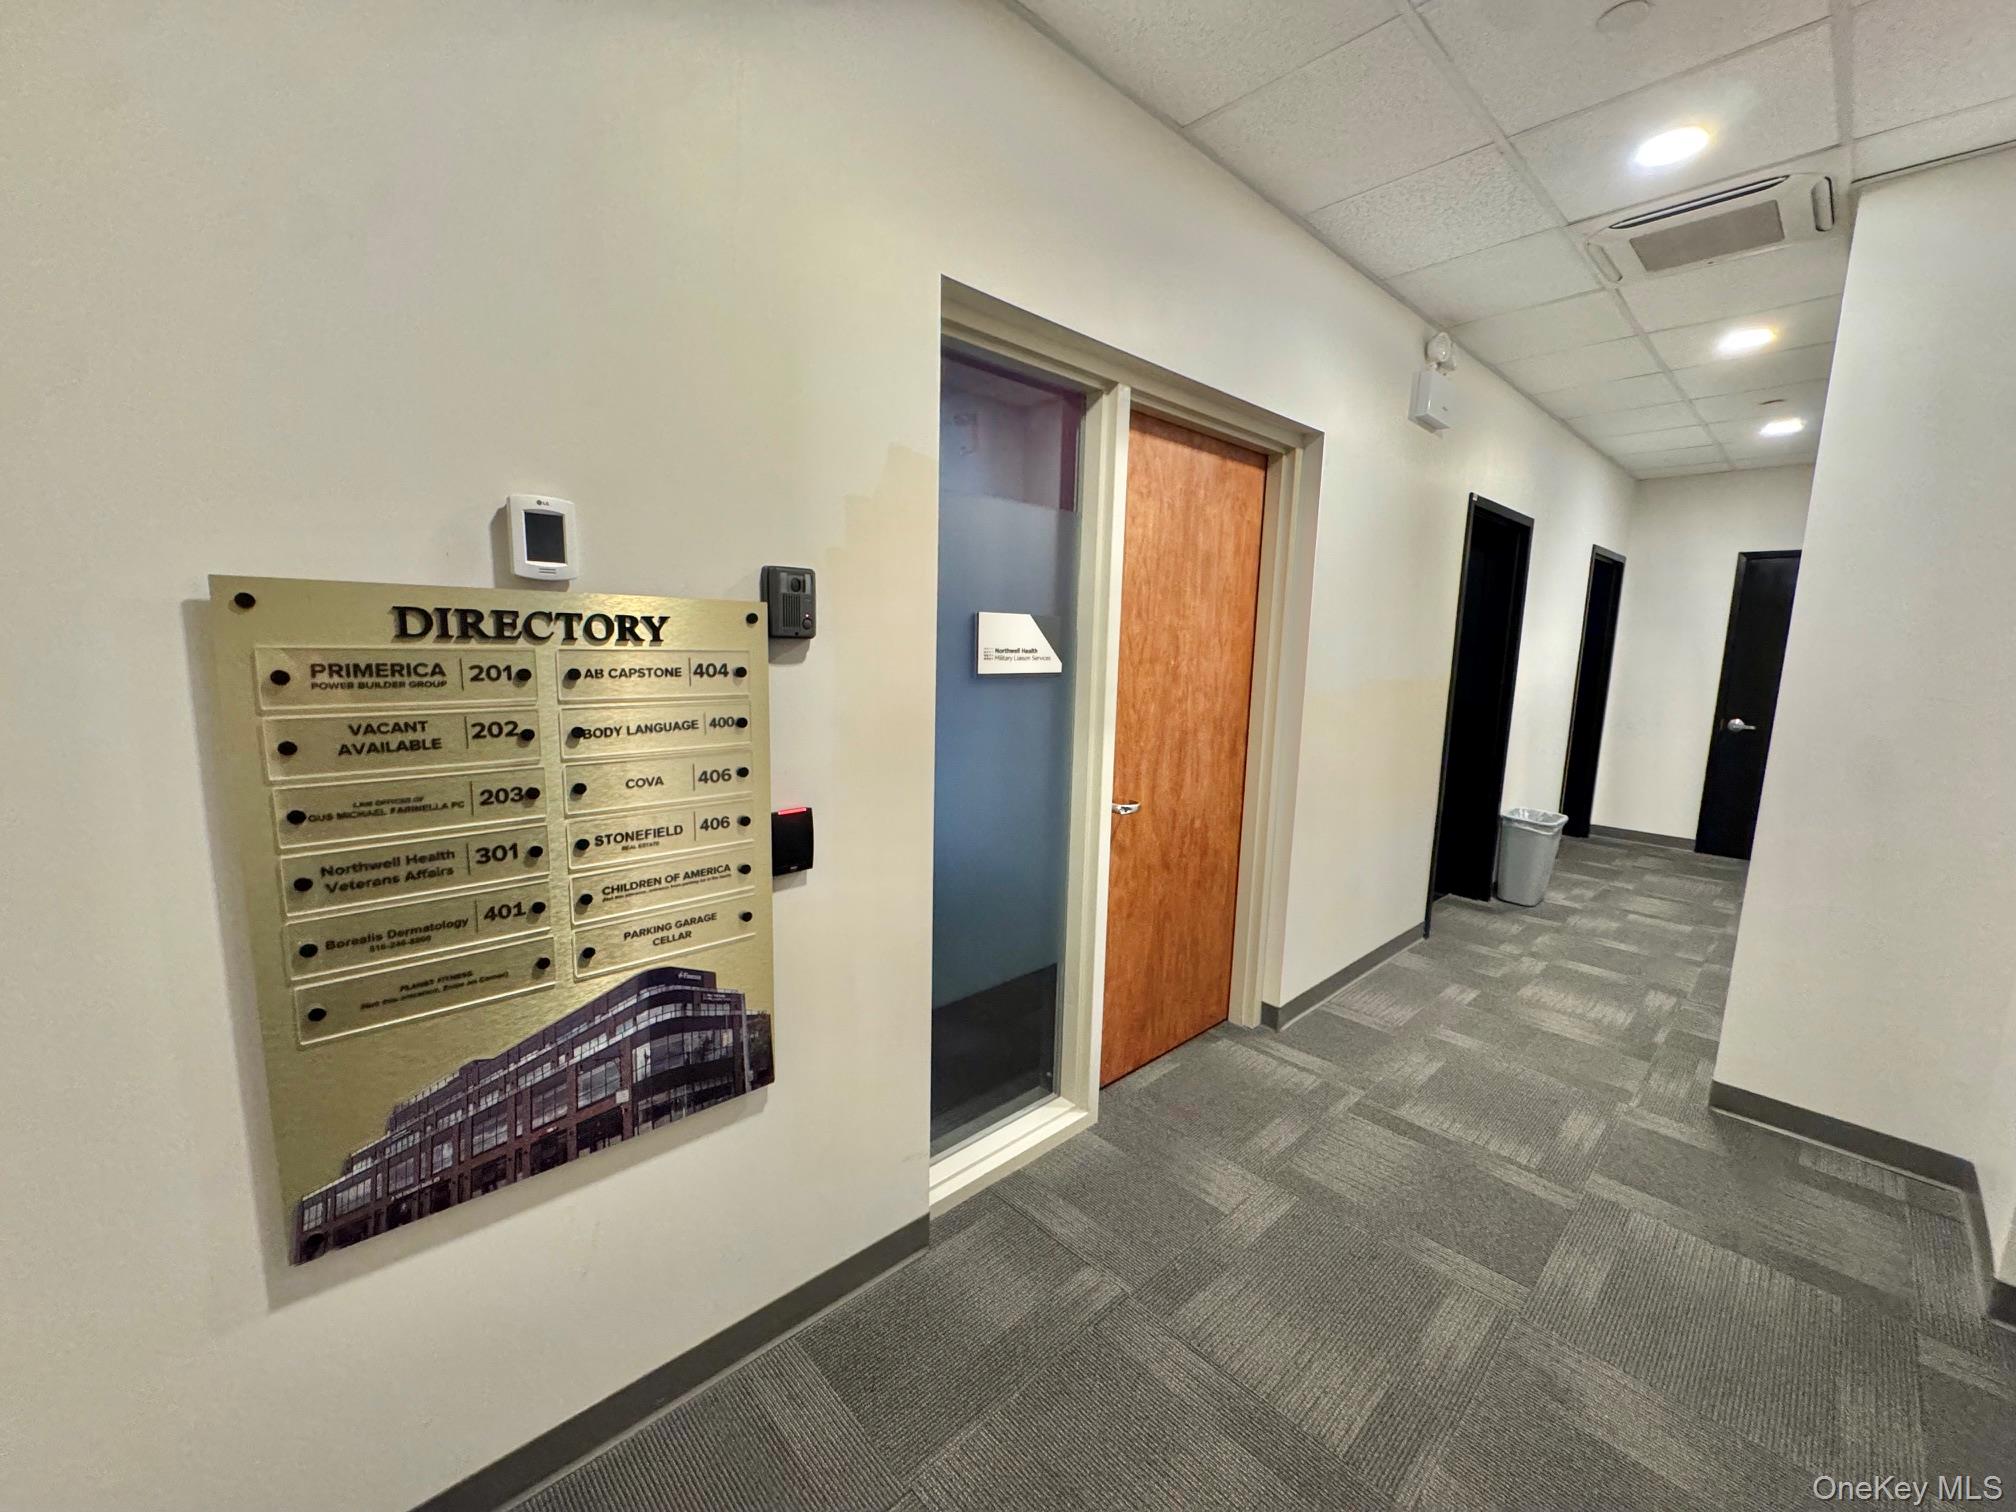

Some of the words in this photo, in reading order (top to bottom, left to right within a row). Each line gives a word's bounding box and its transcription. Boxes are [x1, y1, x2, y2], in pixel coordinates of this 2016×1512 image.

[392, 606, 670, 643] DIRECTORY
[310, 662, 446, 679] PRIMERICA
[469, 664, 513, 682] 201
[584, 668, 604, 679] AB
[608, 667, 682, 679] CAPSTONE
[693, 663, 729, 678] 404
[311, 681, 354, 690] POWER
[357, 680, 406, 689] BUILDER
[409, 680, 447, 688] GROUP
[348, 720, 428, 736] VACANT
[471, 721, 520, 739] 202
[583, 726, 623, 740] BODY
[627, 720, 699, 736] LANGUAGE
[709, 717, 735, 728] 400
[338, 738, 442, 756] AVAILABLE
[625, 776, 664, 789] COVA
[698, 768, 732, 784] 406
[451, 801, 464, 809] PC
[479, 787, 524, 805] 203
[700, 816, 730, 831] 406
[594, 824, 684, 847] STONEFIELD
[475, 843, 519, 864] 301
[320, 856, 401, 877] Northwell
[406, 849, 455, 866] Health
[324, 875, 400, 894] Veterans
[405, 866, 454, 881] Affairs
[602, 877, 662, 896] CHILDREN
[665, 873, 680, 883] OF
[683, 864, 731, 880] AMERICA
[484, 902, 526, 921] 401
[325, 934, 383, 951] Borealis
[387, 917, 469, 939] Dermatology
[624, 922, 672, 941] PARKING
[675, 912, 717, 928] GARAGE
[652, 930, 692, 946] CELLAR
